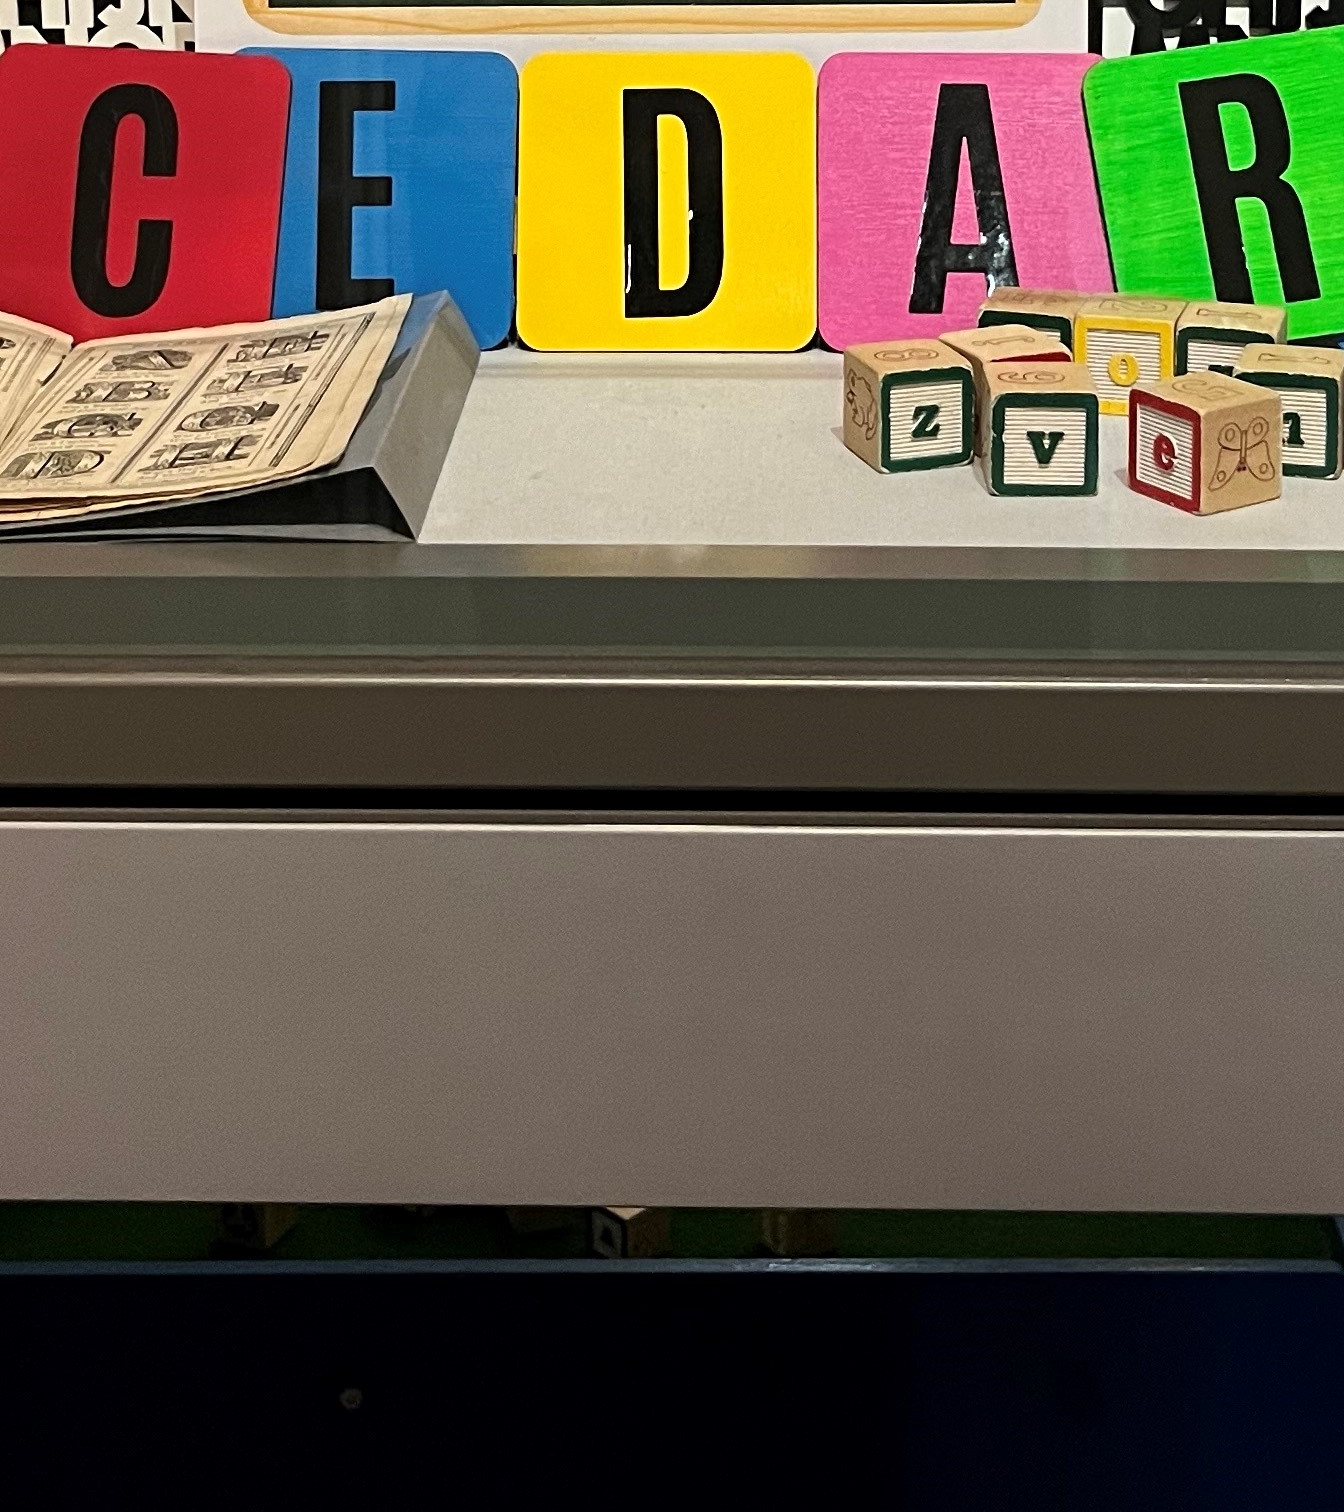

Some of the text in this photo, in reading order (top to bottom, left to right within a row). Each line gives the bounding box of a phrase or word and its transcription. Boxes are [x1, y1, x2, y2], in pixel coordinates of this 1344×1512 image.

[912, 403, 941, 439] z
[1026, 430, 1065, 468] v
[1153, 433, 1177, 472] e
